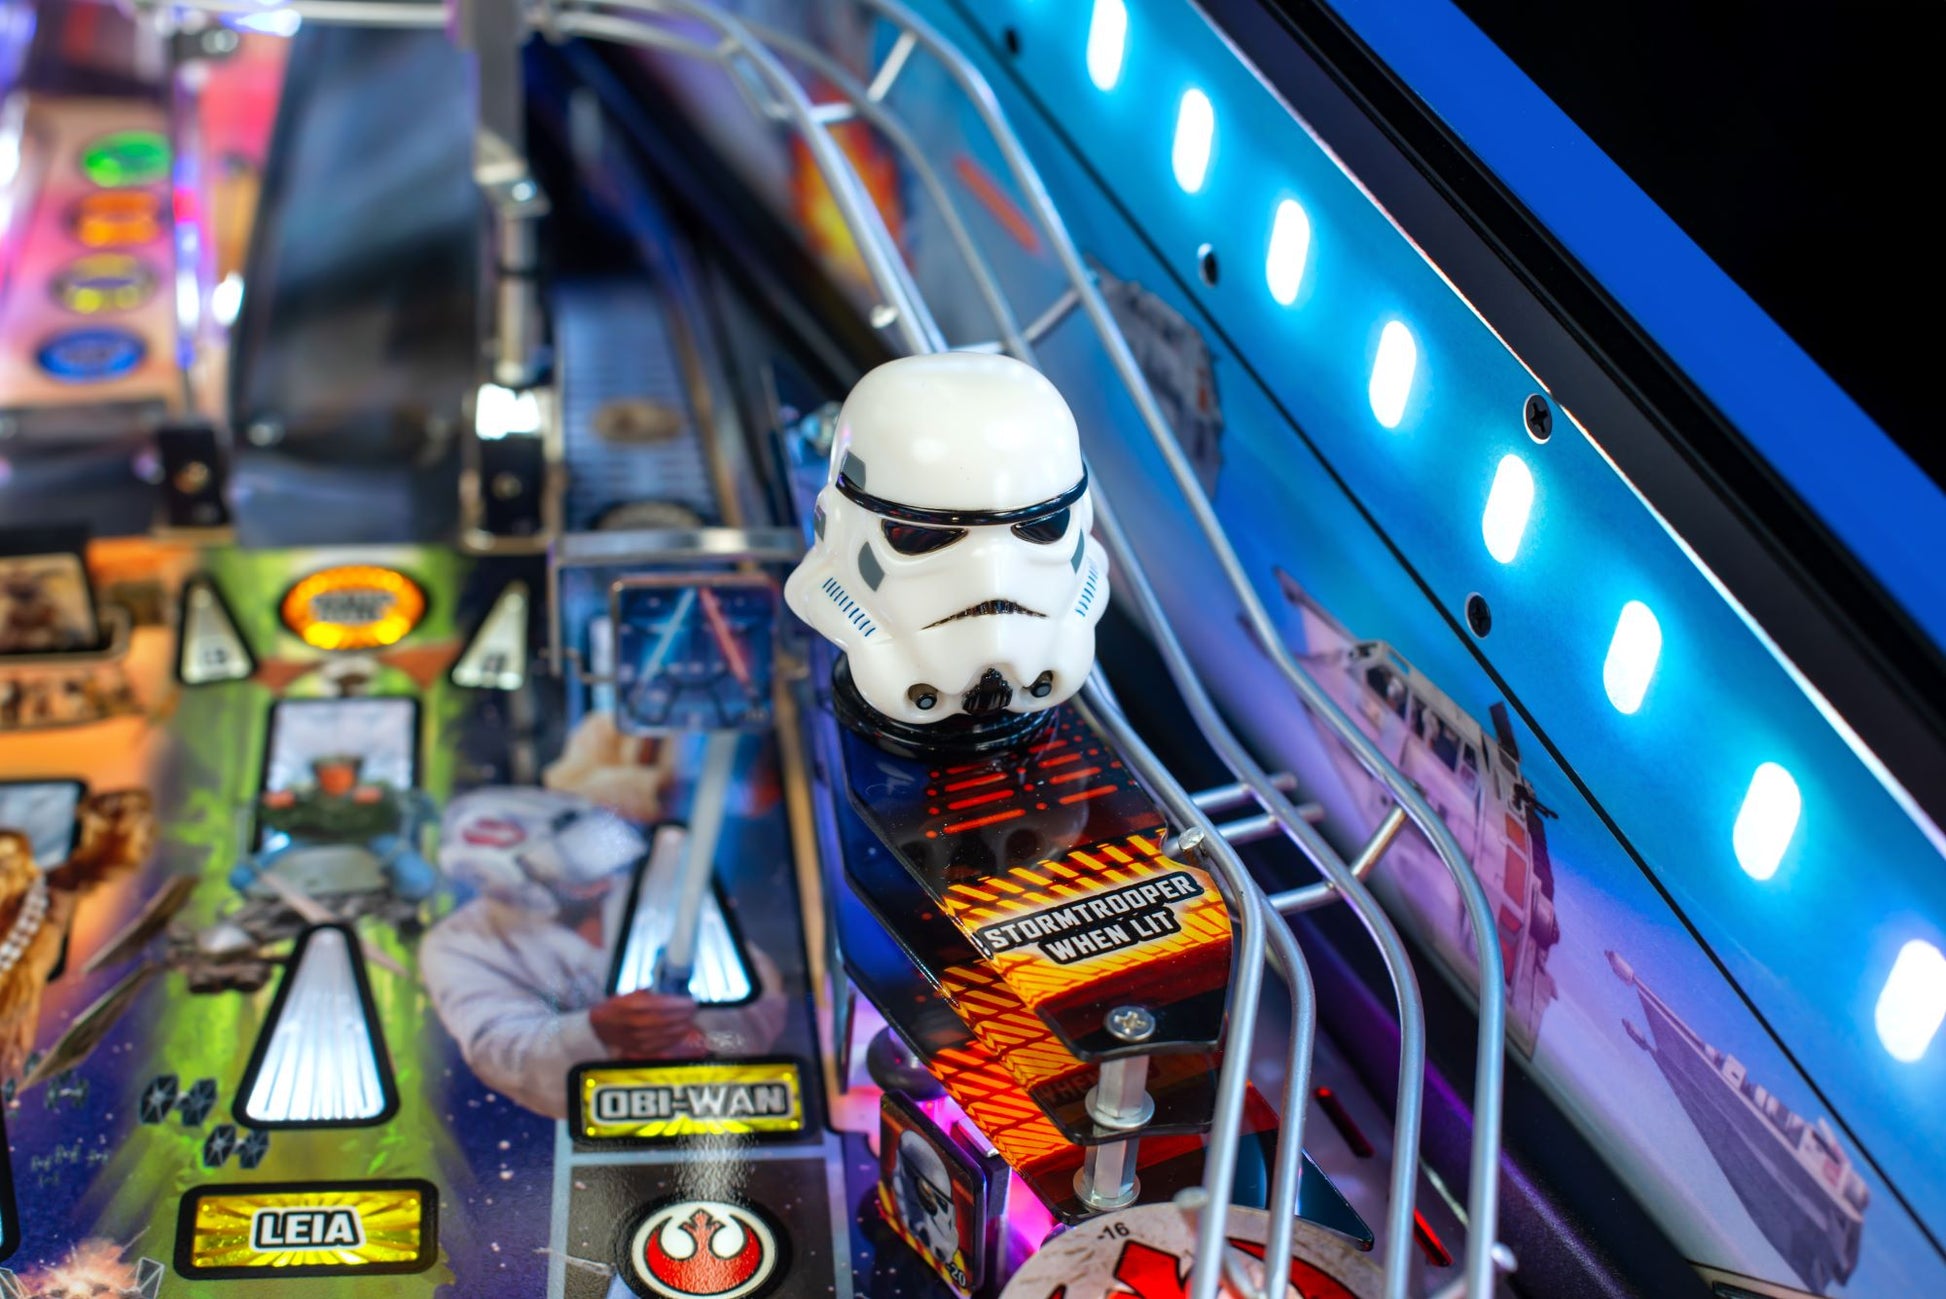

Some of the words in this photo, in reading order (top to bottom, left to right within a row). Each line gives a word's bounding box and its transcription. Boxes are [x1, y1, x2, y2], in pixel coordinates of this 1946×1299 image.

[984, 875, 1197, 949] STORMTROOPER
[1045, 925, 1131, 961] WHEN
[1131, 910, 1174, 937] LIT
[601, 1085, 786, 1118] OBI-WAN
[260, 1213, 354, 1244] LEIA
[1097, 1222, 1130, 1240] -16
